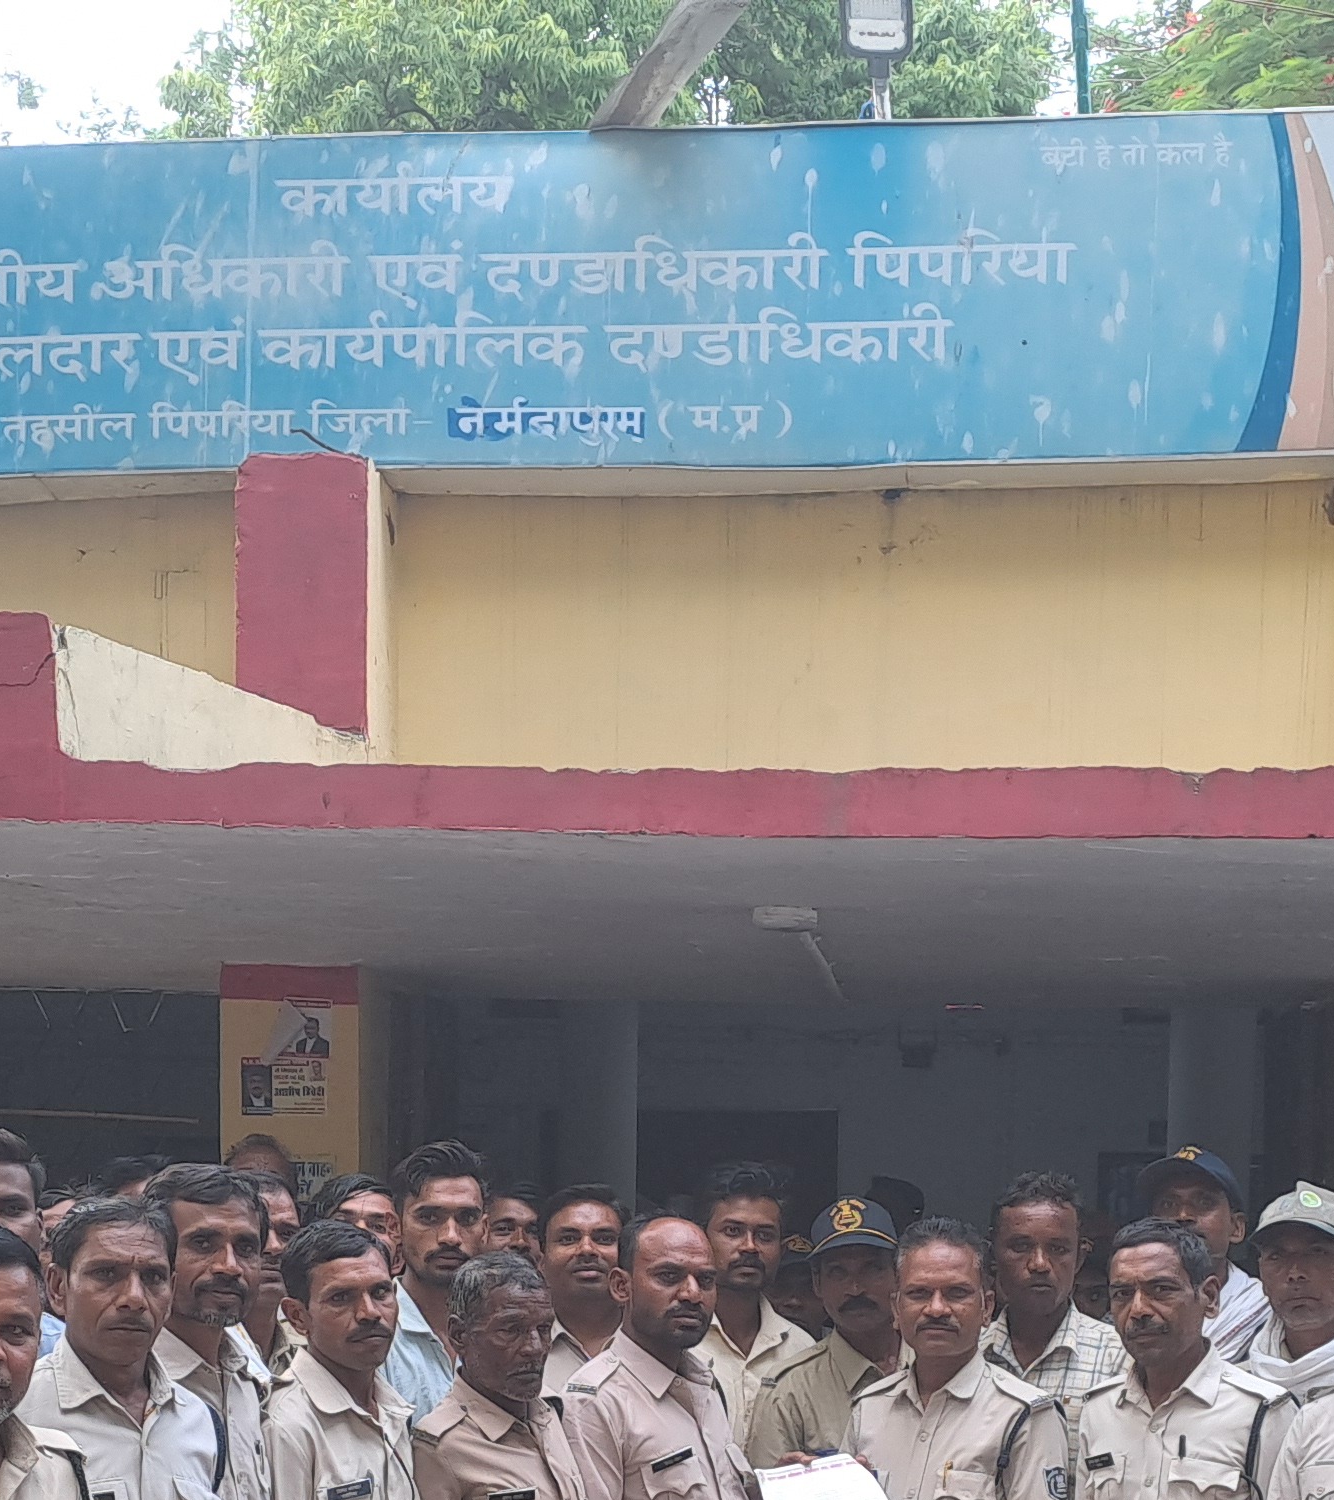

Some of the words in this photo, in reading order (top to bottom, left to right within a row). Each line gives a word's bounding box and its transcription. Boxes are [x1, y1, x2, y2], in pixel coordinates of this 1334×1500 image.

[1039, 137, 1088, 168] बेटी
[1095, 136, 1114, 170] है
[1119, 136, 1148, 166] तो
[1155, 142, 1205, 165] कल
[1213, 131, 1234, 167] है
[274, 160, 515, 219] कार्यालय
[95, 241, 351, 307] अधिकारी
[368, 238, 463, 310] एवं
[481, 233, 829, 298] दण्डाधिकारी
[846, 228, 1078, 287] पिपरिया
[150, 316, 245, 385] एवं
[258, 306, 588, 371] कार्यपालिक
[604, 303, 954, 370] दण्डाधिकारी
[0, 403, 137, 443] तहसील
[148, 401, 296, 440] पिपरिया
